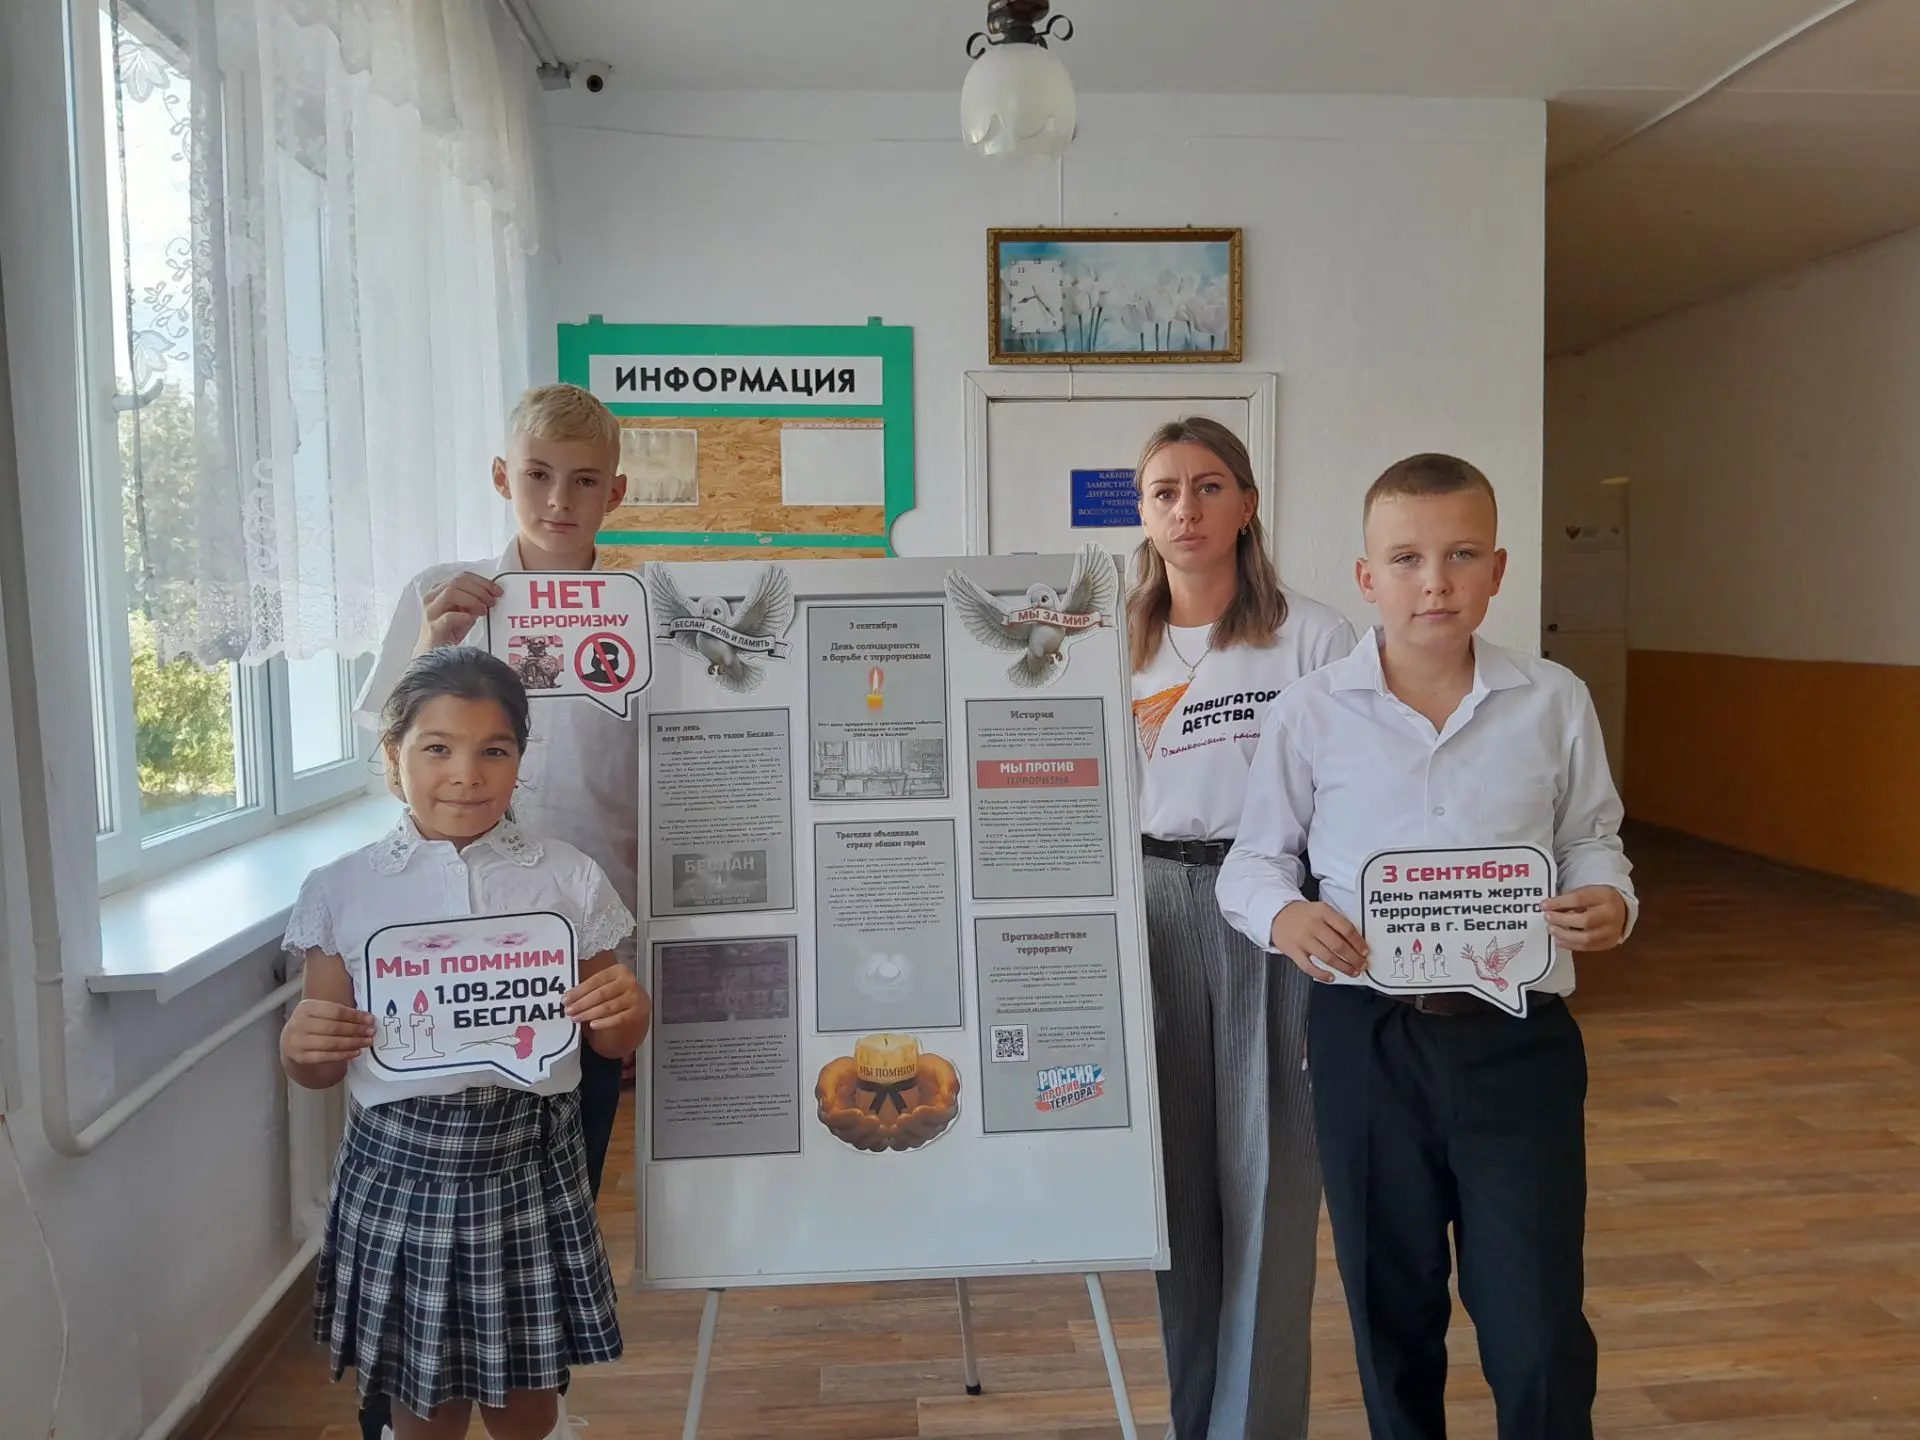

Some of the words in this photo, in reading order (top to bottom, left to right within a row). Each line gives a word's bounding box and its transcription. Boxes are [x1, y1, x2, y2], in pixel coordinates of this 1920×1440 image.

[615, 366, 856, 397] ИНФОРМАЦИЯ
[529, 580, 606, 609] НЕТ
[507, 614, 629, 630] ТЕРРОРИЗМУ
[849, 622, 854, 630] 3
[856, 621, 898, 631] сентября
[1018, 610, 1040, 621] МЫ
[1043, 610, 1060, 623] ЗА
[1062, 614, 1091, 625] МИР
[675, 619, 706, 629] БЕСЛАН
[710, 625, 730, 639] БОЛЬ
[731, 634, 737, 642] И
[738, 637, 770, 648] ПАМЯТЬ
[831, 642, 854, 651] День
[856, 642, 920, 652] солидарности
[829, 653, 862, 663] борьбе
[869, 653, 932, 663] терроризмом
[1183, 690, 1281, 716] НАВИГАТОР
[1010, 710, 1055, 721] История
[1181, 708, 1255, 735] ДЕТСТВА
[1000, 762, 1023, 774] МЫ
[1026, 761, 1075, 773] ПРОТИВ
[684, 856, 755, 873] БЕСЛАН
[1382, 865, 1398, 883] 3
[1406, 860, 1530, 883] сентября
[1369, 890, 1413, 905] День
[1418, 888, 1483, 901] память
[1488, 886, 1543, 902] жертв
[1370, 902, 1543, 920] террористического
[1386, 921, 1425, 934] акта
[1430, 921, 1441, 932] в
[1445, 921, 1459, 932] г.
[1464, 919, 1528, 932] Беслан
[1001, 931, 1088, 943] Противодействие
[1016, 945, 1074, 956] терроризму
[375, 956, 430, 979] Мы
[433, 976, 567, 1005] 1.09.2004
[453, 1002, 566, 1029] БЕСЛАН
[859, 1066, 873, 1077] МЫ
[875, 1064, 916, 1078] ПОМНИМ
[1038, 1064, 1095, 1090] РОССИЯ
[1041, 1080, 1080, 1102] ПРОТИВ
[1050, 1083, 1097, 1110] ТЕРРОРА!
